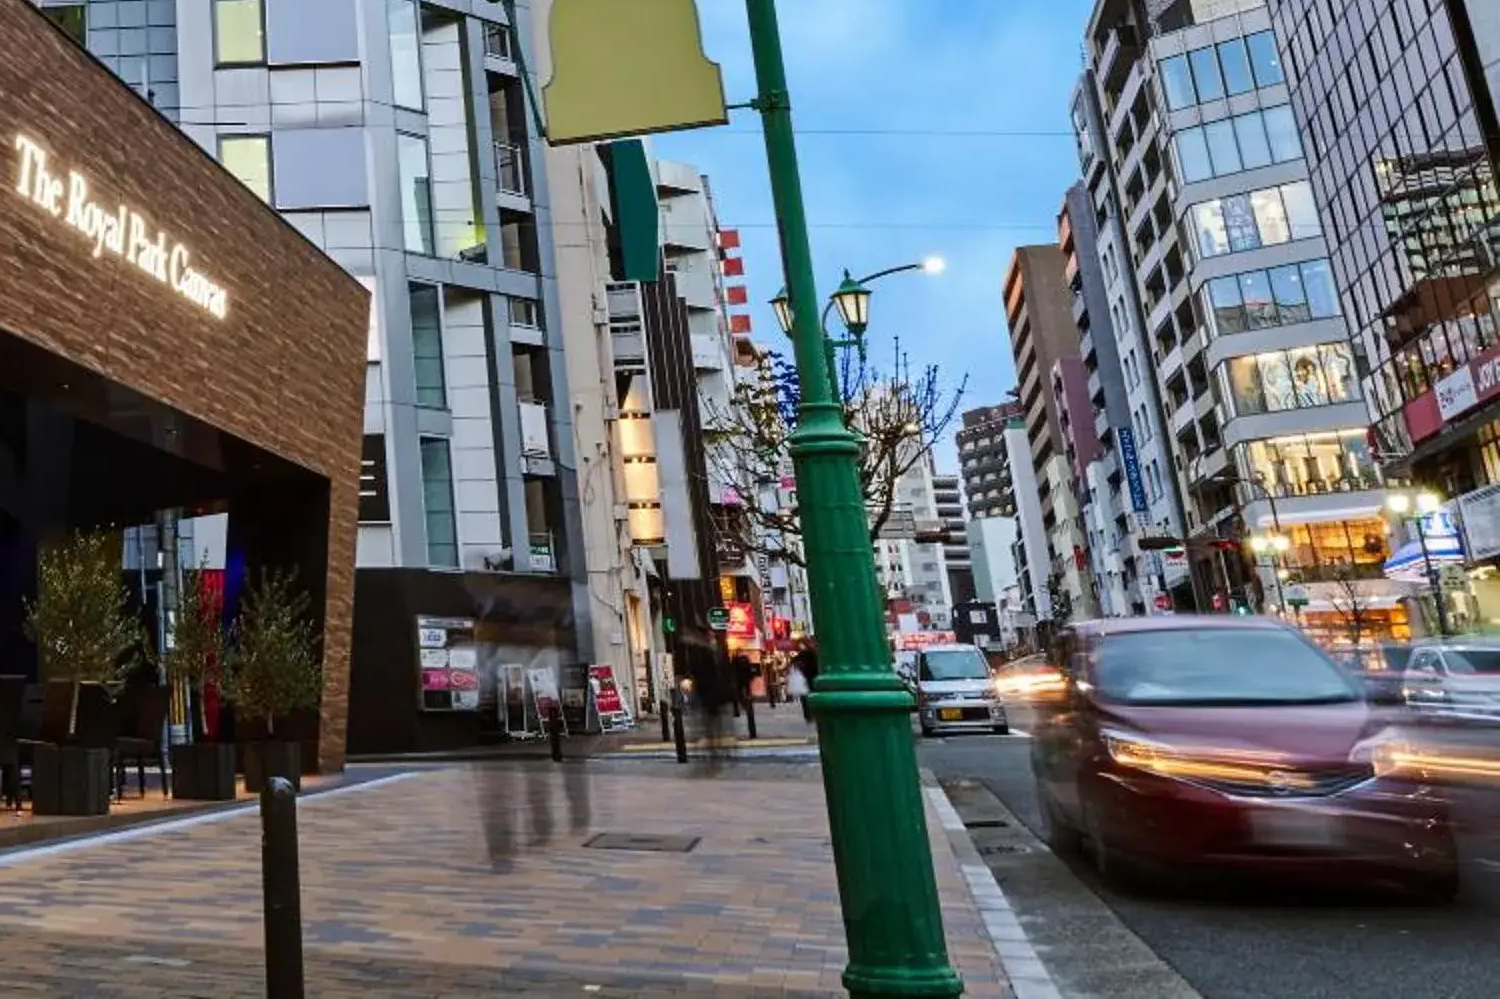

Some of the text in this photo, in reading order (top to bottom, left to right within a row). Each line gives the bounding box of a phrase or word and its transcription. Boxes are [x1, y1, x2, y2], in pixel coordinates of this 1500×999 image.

[15, 134, 63, 217] The
[65, 169, 128, 258] Royal
[126, 211, 169, 283] Park
